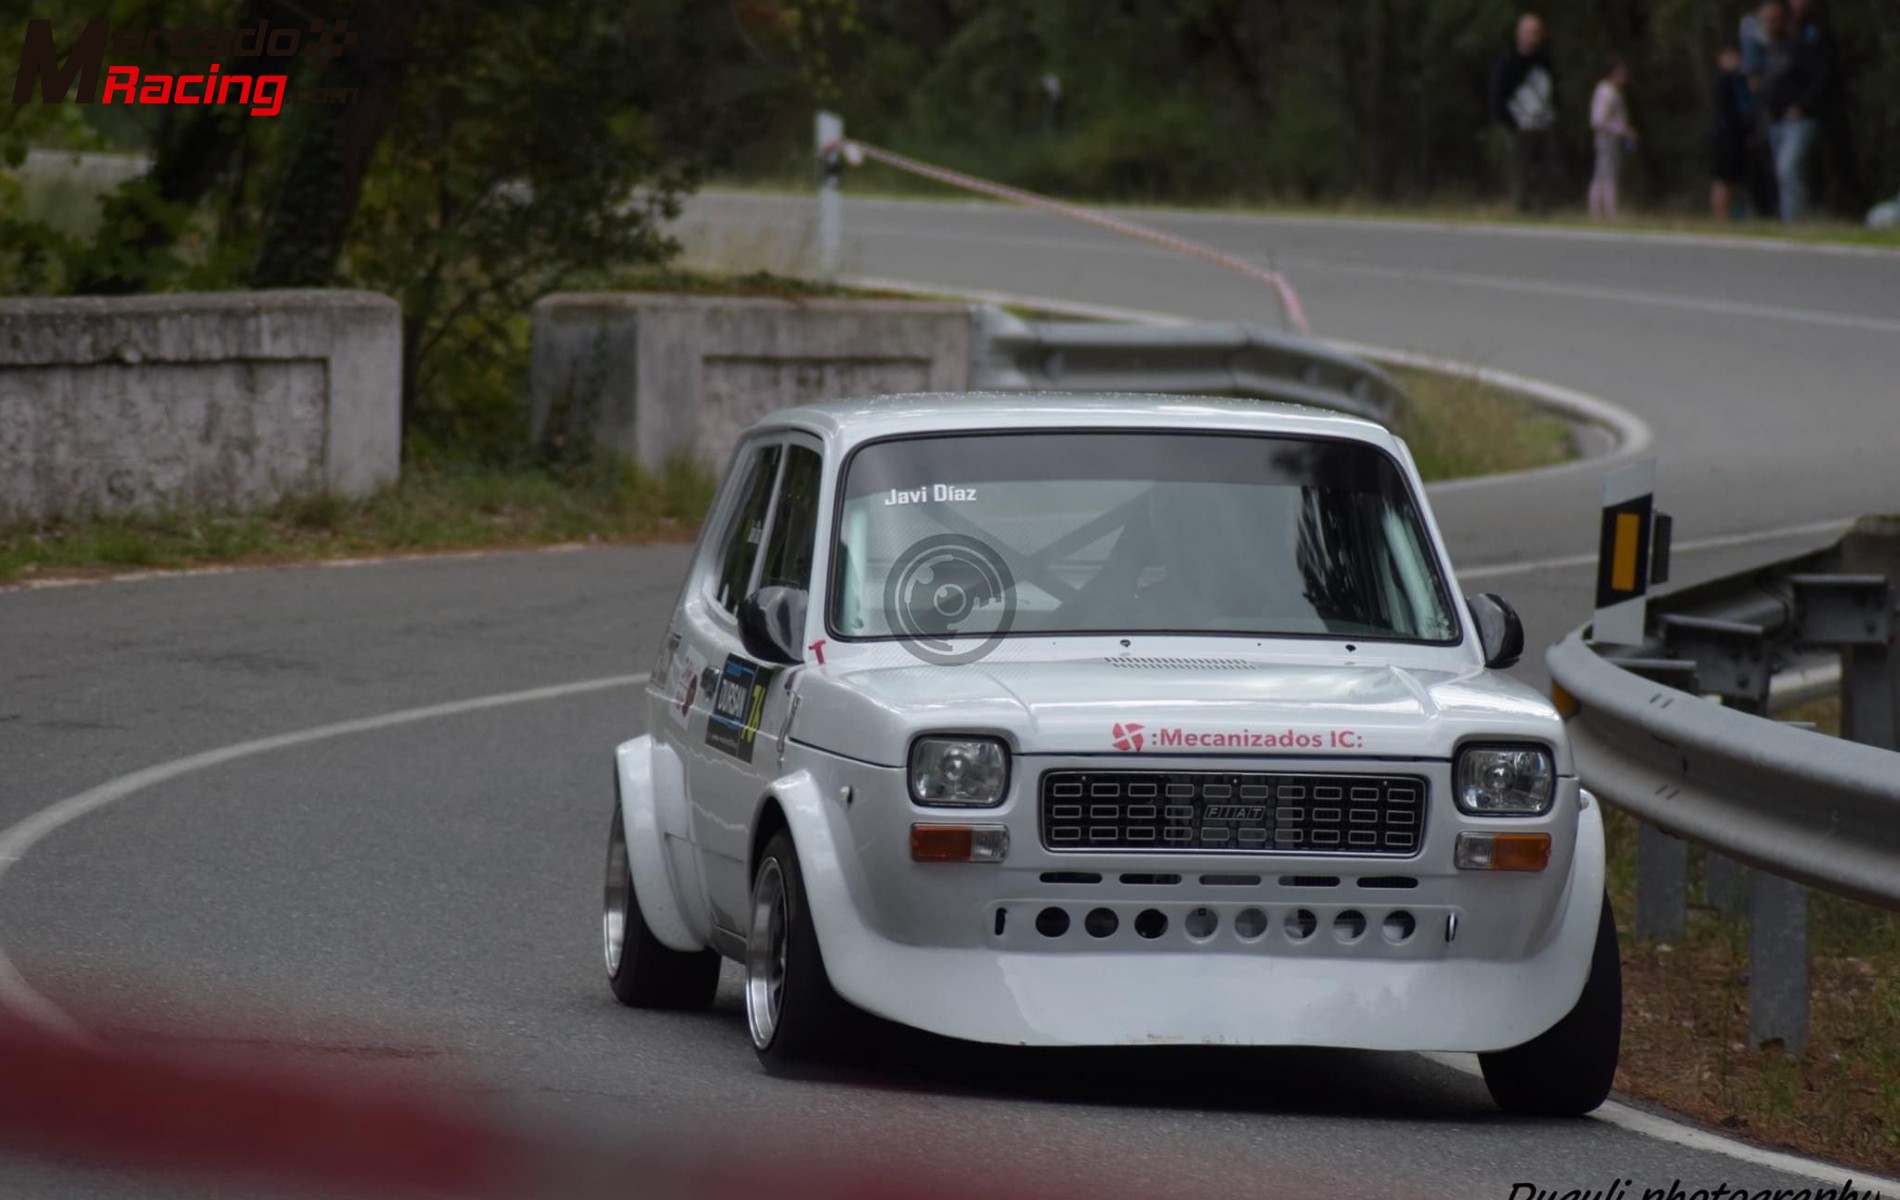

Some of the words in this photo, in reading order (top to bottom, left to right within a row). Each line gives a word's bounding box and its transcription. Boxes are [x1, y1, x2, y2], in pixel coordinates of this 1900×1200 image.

[885, 487, 927, 506] Javi
[934, 484, 977, 502] Díaz
[1206, 806, 1264, 819] FIAT
